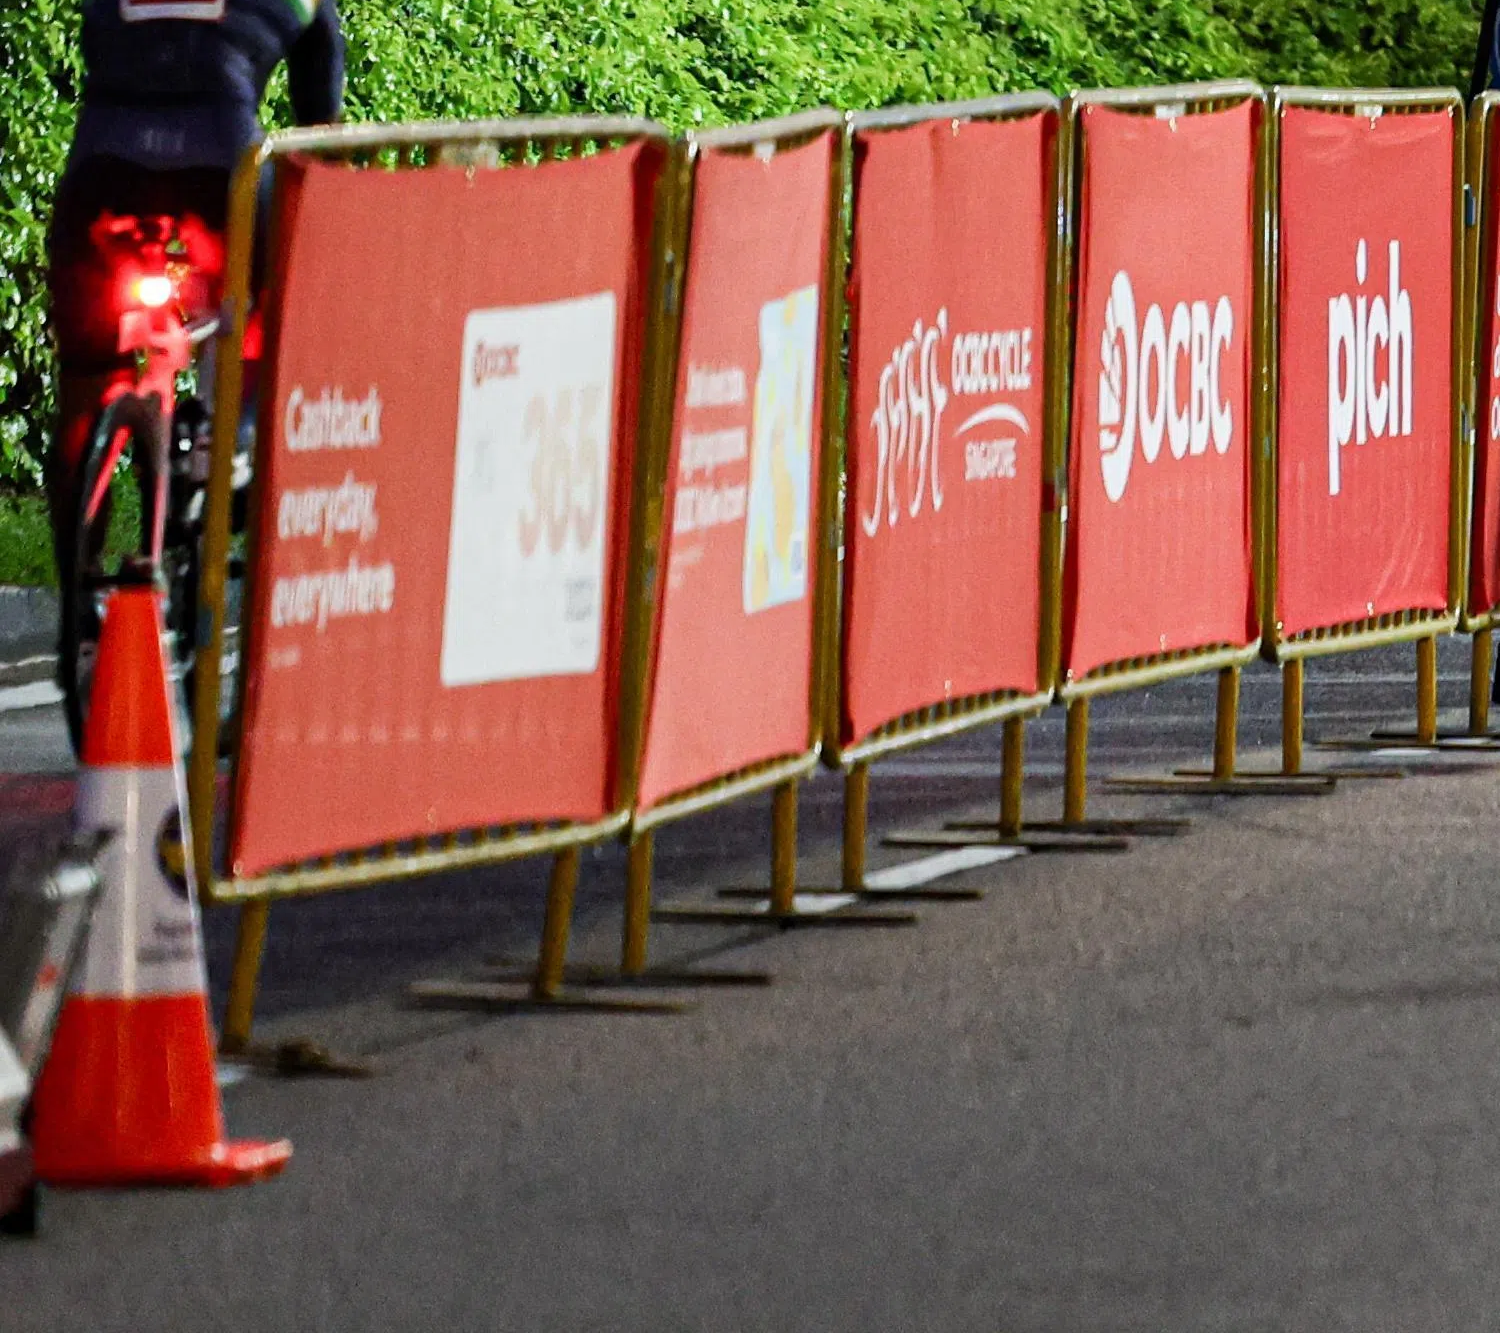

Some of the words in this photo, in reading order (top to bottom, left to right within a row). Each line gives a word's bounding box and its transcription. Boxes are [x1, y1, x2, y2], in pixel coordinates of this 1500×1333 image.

[1135, 295, 1234, 464] OCBC
[1328, 238, 1414, 496] pich
[284, 384, 383, 454] Cashback
[277, 468, 379, 549] everyday,
[270, 555, 396, 636] everywhere
